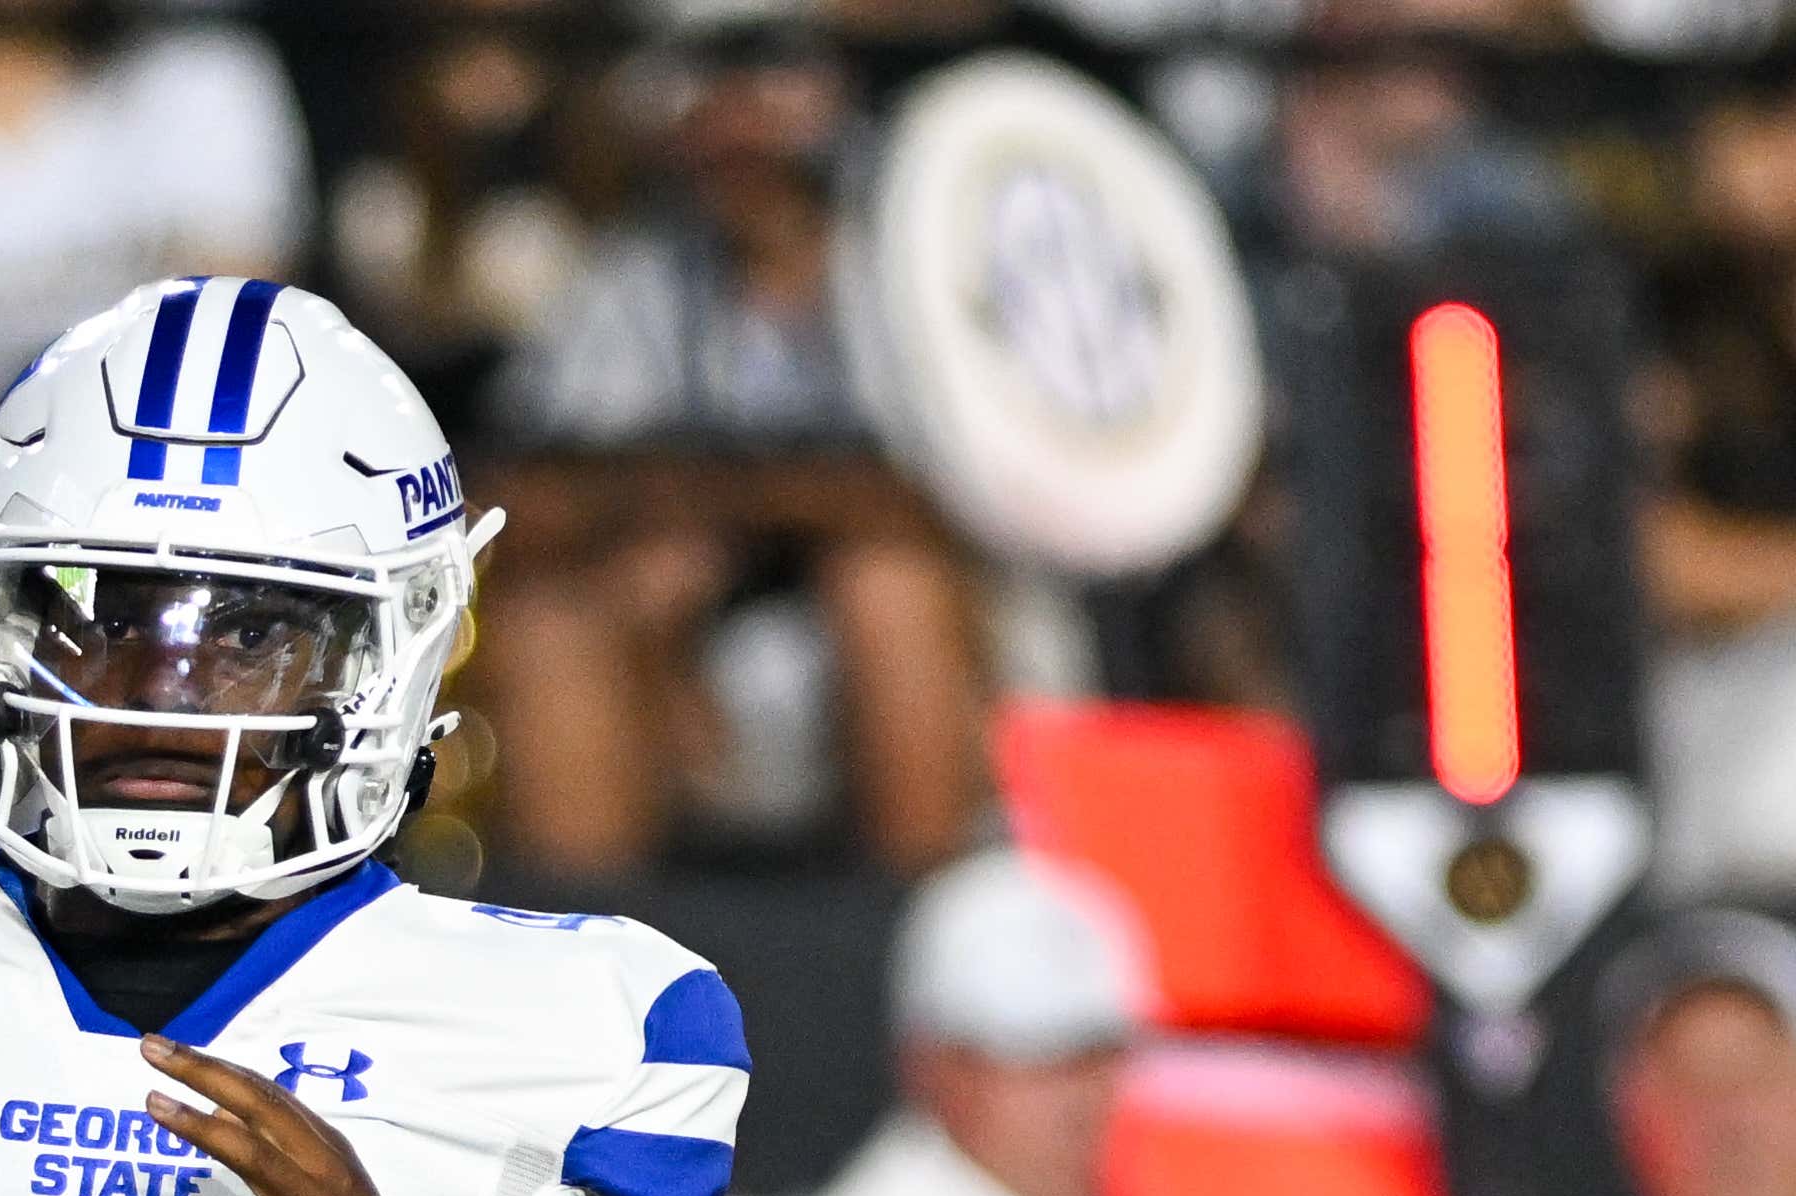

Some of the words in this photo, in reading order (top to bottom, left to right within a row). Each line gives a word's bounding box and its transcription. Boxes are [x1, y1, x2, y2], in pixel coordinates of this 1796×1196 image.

[134, 492, 222, 512] PANTHERS
[116, 827, 181, 842] Riddell
[0, 1099, 212, 1160] GEORG
